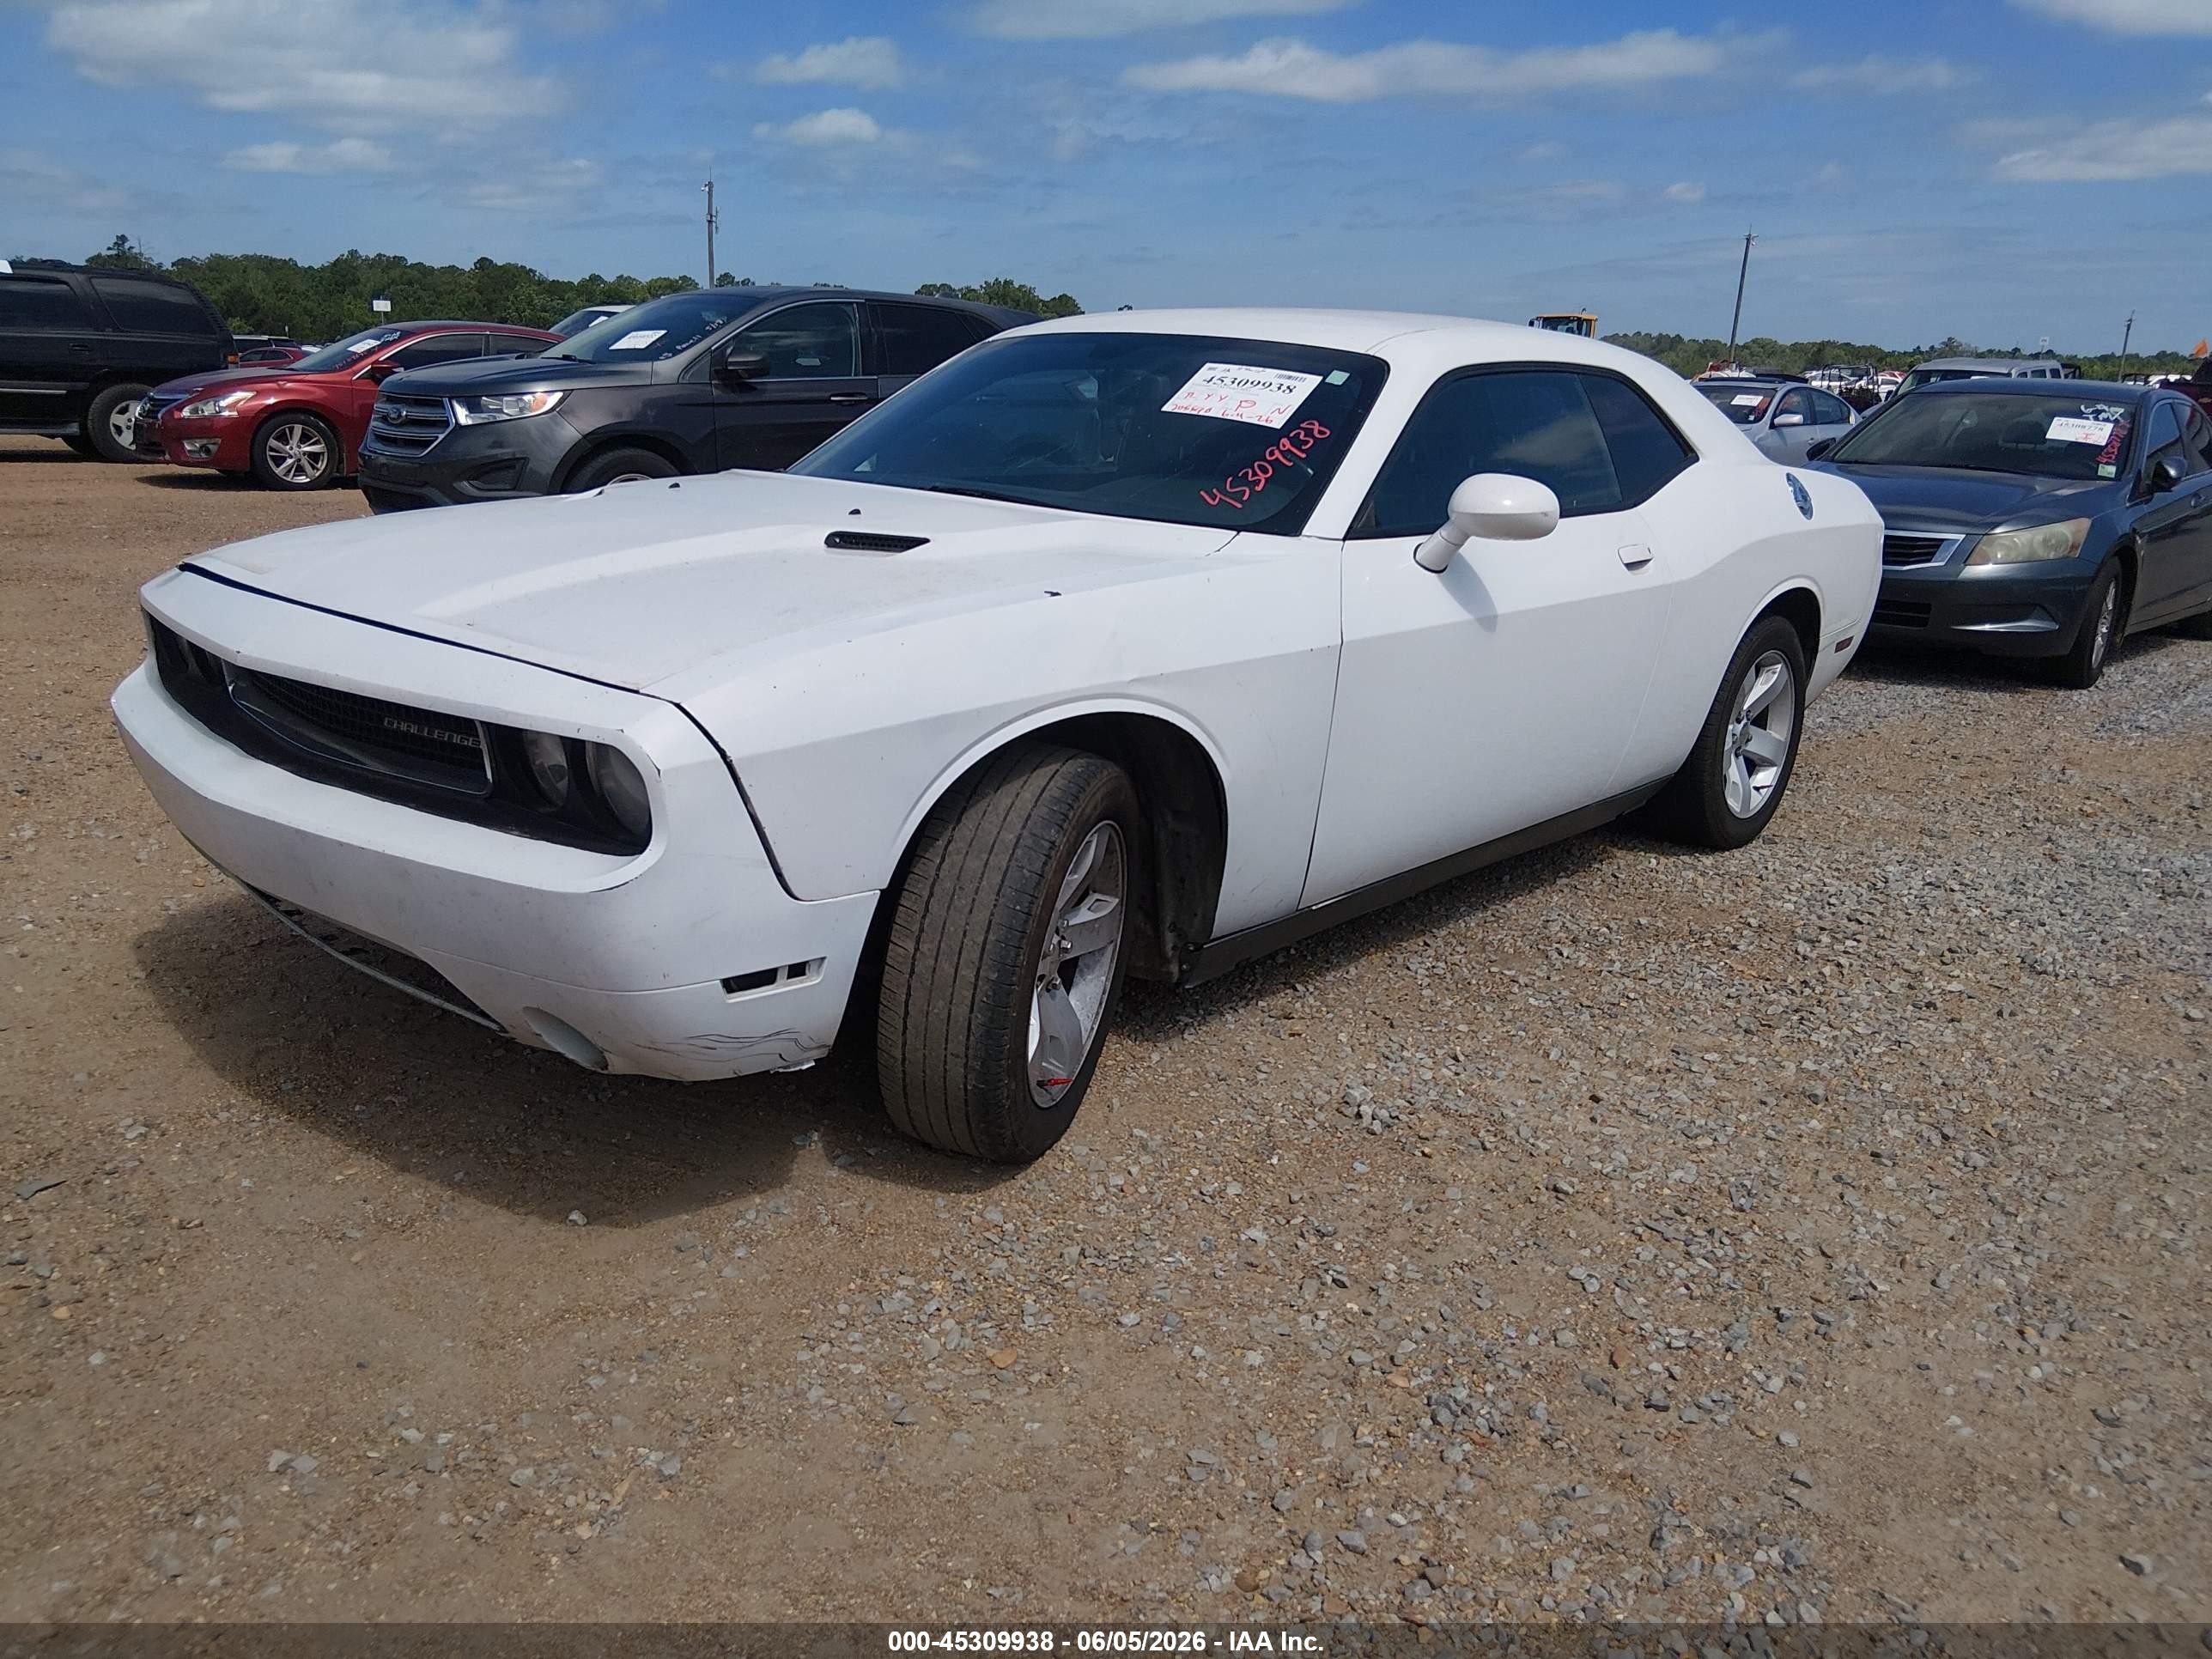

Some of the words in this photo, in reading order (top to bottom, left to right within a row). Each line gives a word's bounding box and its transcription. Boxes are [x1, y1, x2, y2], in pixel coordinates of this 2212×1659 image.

[1203, 375, 1297, 394] 45309938
[1200, 420, 1331, 508] 45309938
[383, 717, 483, 749] CHALLENGE
